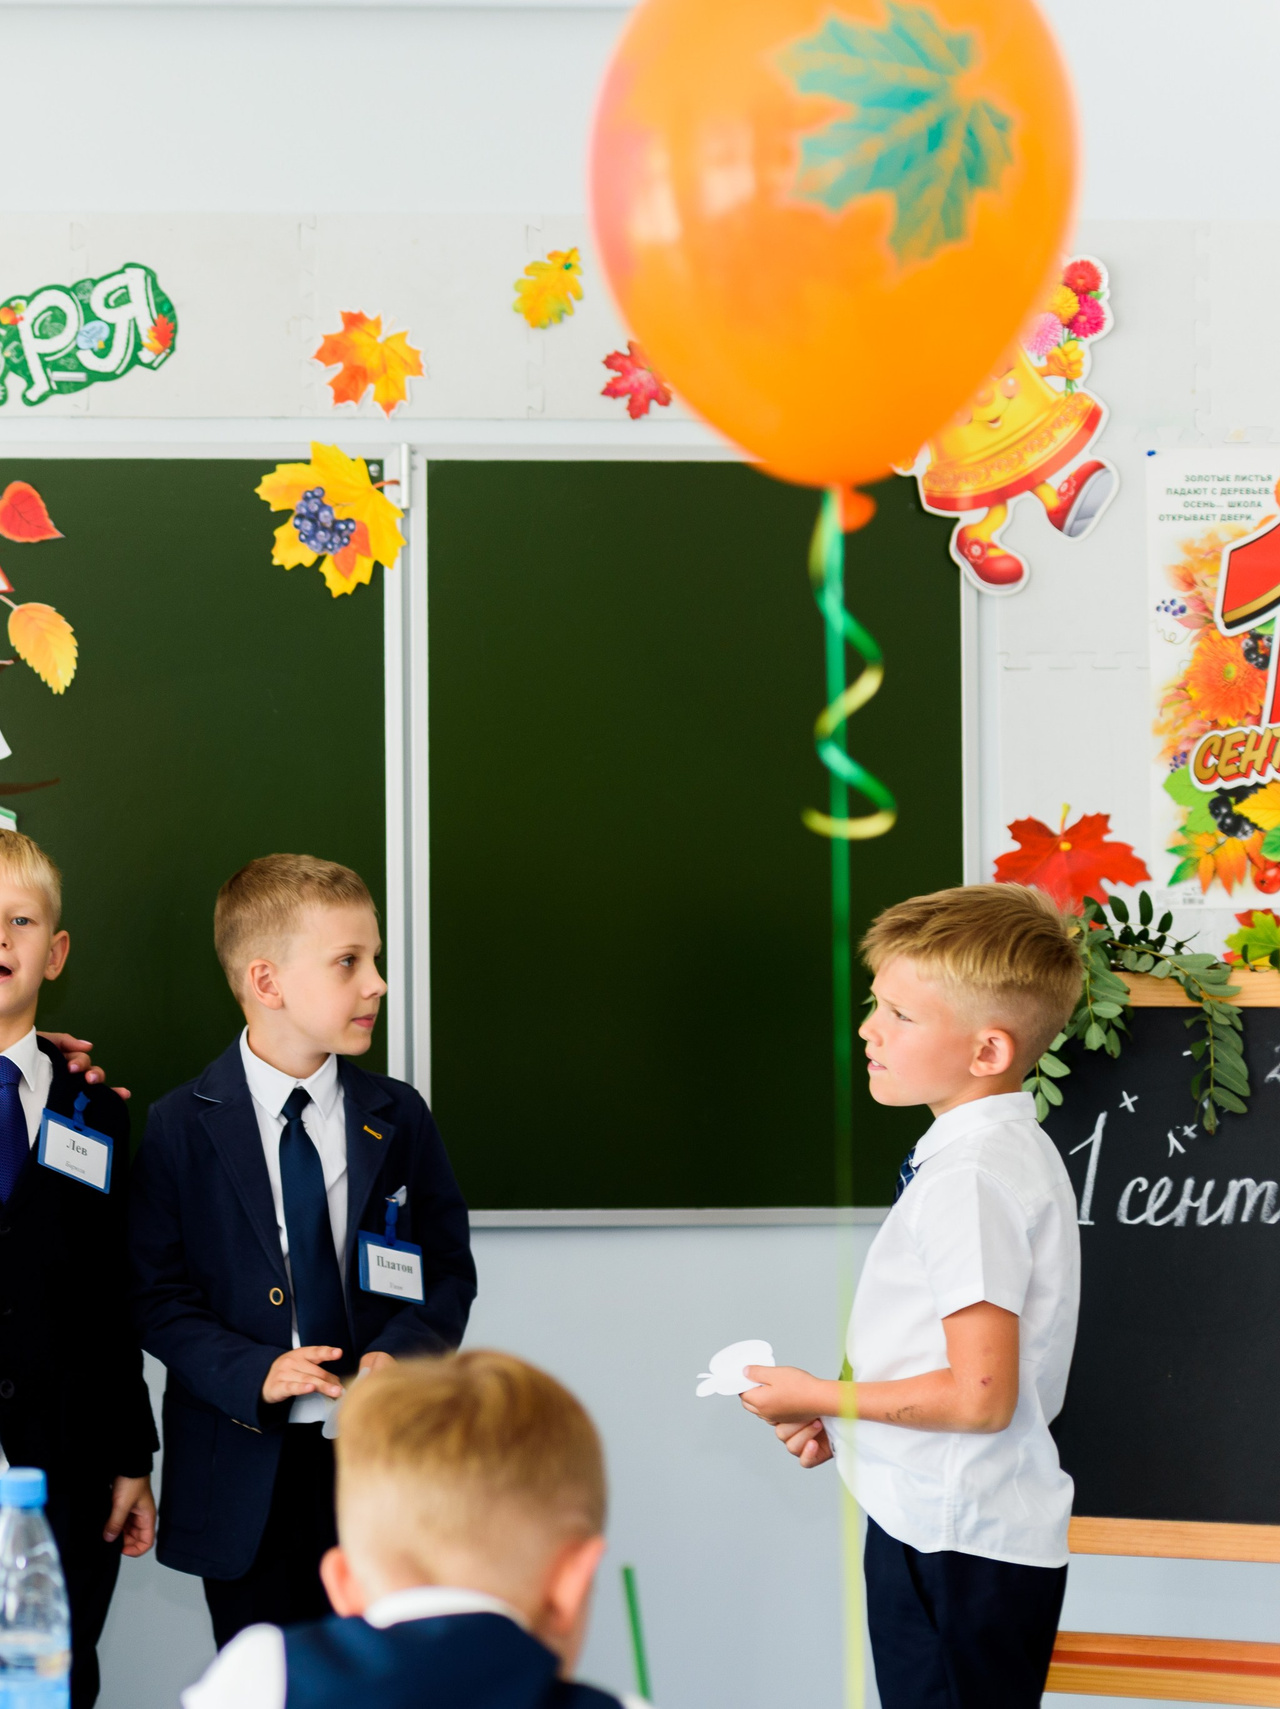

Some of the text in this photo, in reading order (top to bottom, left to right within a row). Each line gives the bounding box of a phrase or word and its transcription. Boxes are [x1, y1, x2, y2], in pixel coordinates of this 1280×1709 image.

[1184, 474, 1273, 482] ЗОЛОТЫЕ ЛИСТЬЯ
[1166, 487, 1208, 496] ПАДАЮТ
[1211, 487, 1218, 495] С
[1227, 500, 1263, 508] ШКОЛА
[1158, 513, 1218, 521] ОТКРЫВАЕТ
[66, 1138, 88, 1156] Лев
[1069, 1110, 1108, 1226] 1
[376, 1255, 414, 1274] Платон
